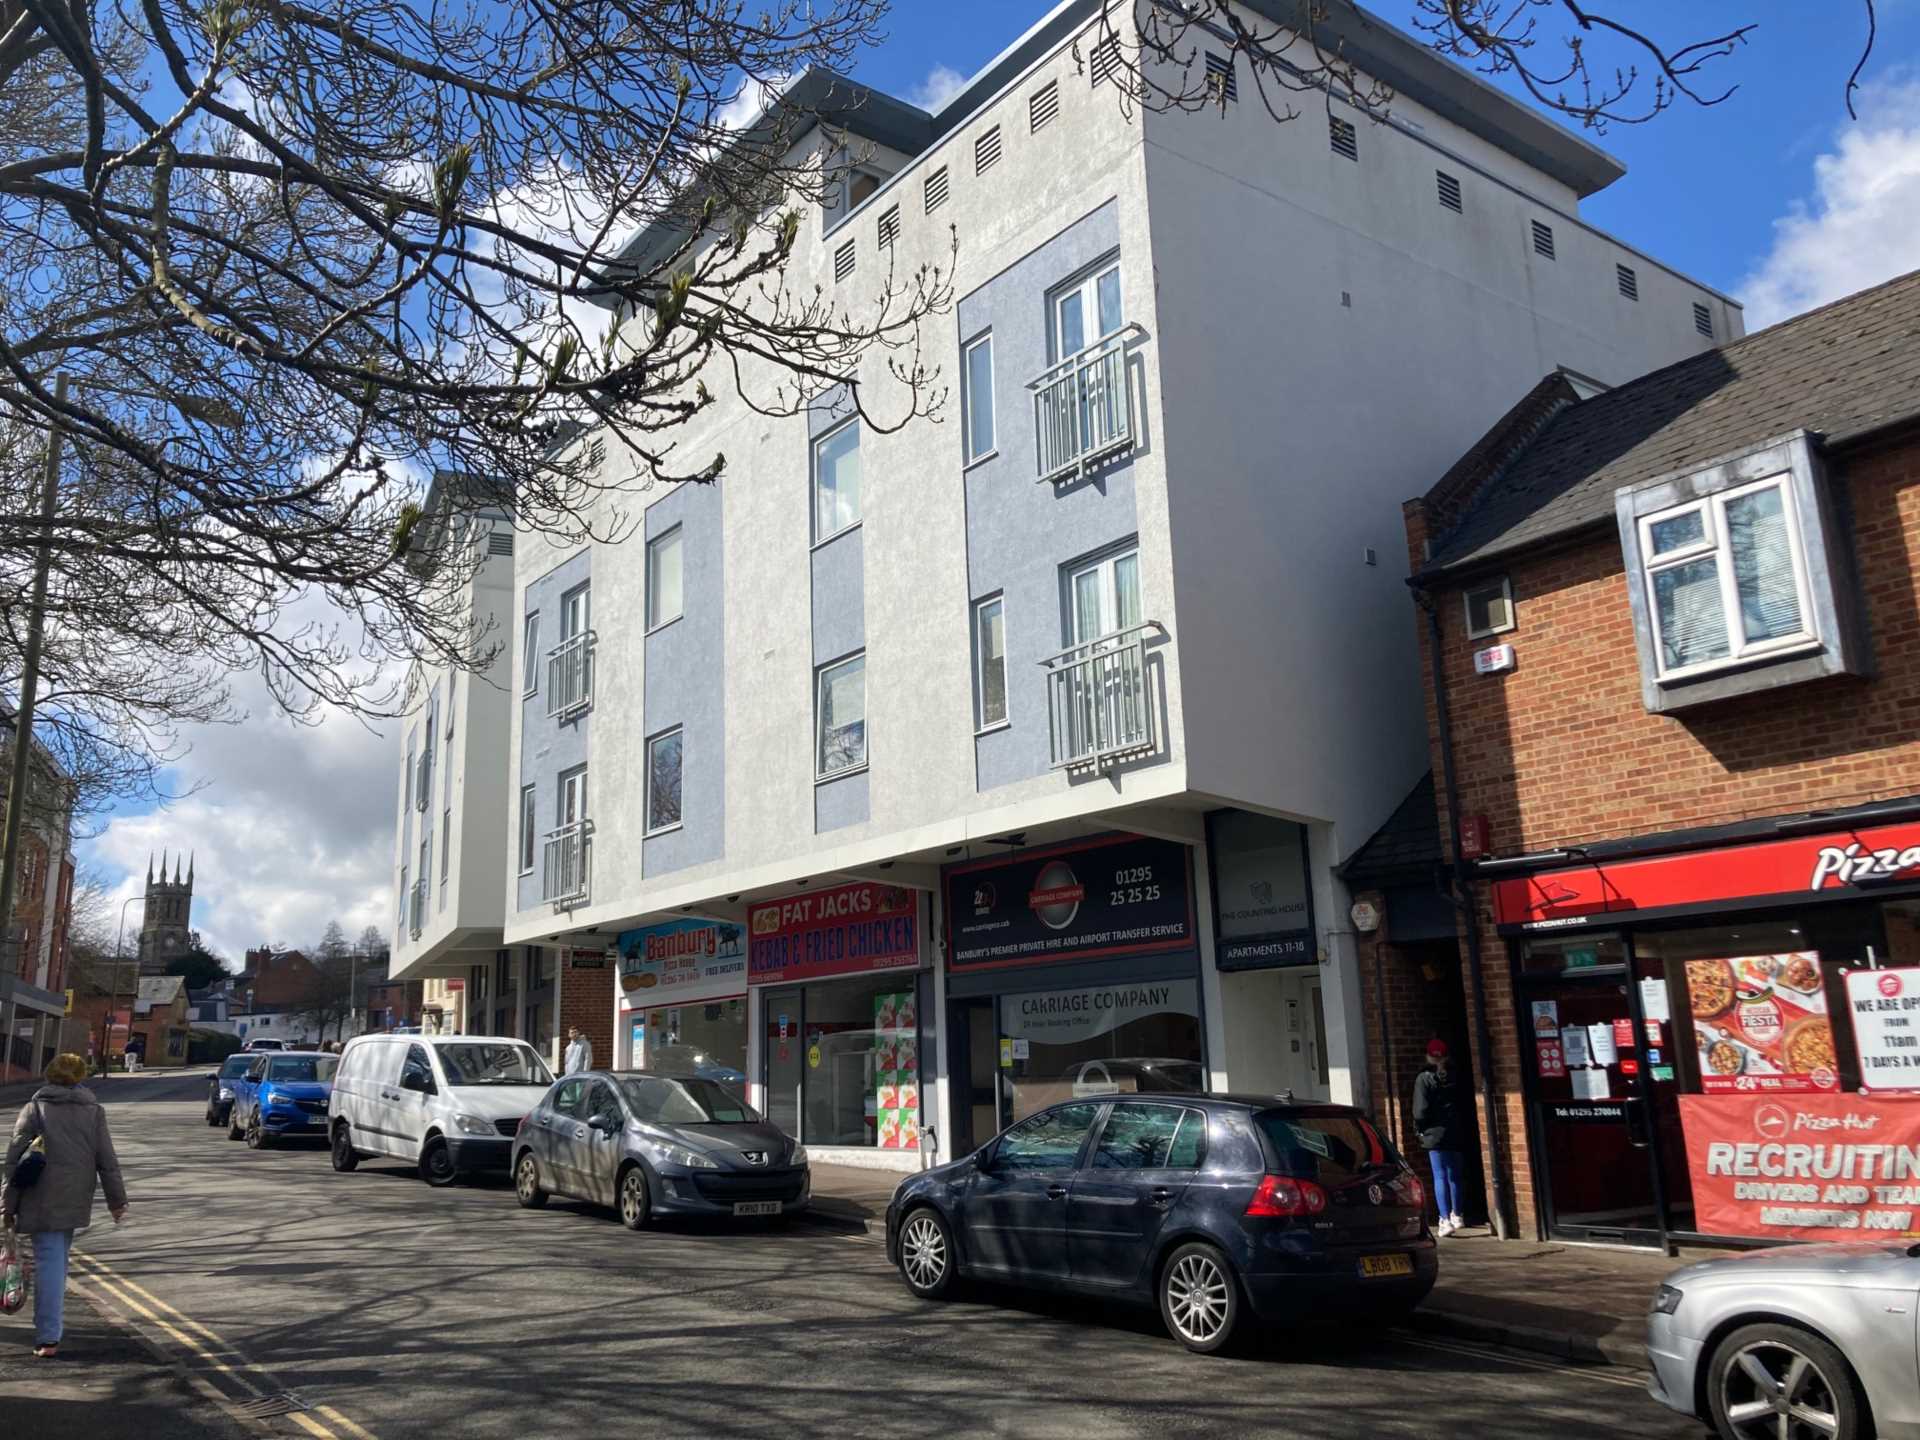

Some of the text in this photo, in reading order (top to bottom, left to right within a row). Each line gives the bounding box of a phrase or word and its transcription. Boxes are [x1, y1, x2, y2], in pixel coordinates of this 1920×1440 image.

[1116, 866, 1152, 885] 01295
[1812, 844, 1920, 890] Pizza
[1111, 885, 1160, 906] 25 25 25
[783, 889, 871, 925] FAT JACKS
[1279, 903, 1305, 913] HOUSE
[645, 925, 716, 961] Banbury
[752, 936, 788, 971] KEBAB
[806, 927, 844, 961] FRIED
[850, 916, 913, 958] CHICKEN
[957, 923, 1184, 960] BANBURY'S PREMIER PRIVATE HIRE AND AIRPORT TRANSFER SERVICE
[1227, 944, 1283, 959] APARTMENTS
[1022, 987, 1169, 1016] CARRIAGE COMPANY
[1855, 996, 1920, 1012] WE ARE OP
[1743, 1015, 1779, 1027] FIESTA
[1884, 1017, 1909, 1027] FROM
[1872, 1056, 1901, 1068] DAYS
[1903, 1056, 1911, 1067] A
[1794, 1112, 1881, 1131] Pizza Hut
[1735, 1182, 1920, 1205] DRIVERS AND TEA
[1760, 1206, 1913, 1231] MEMBERS NOW
